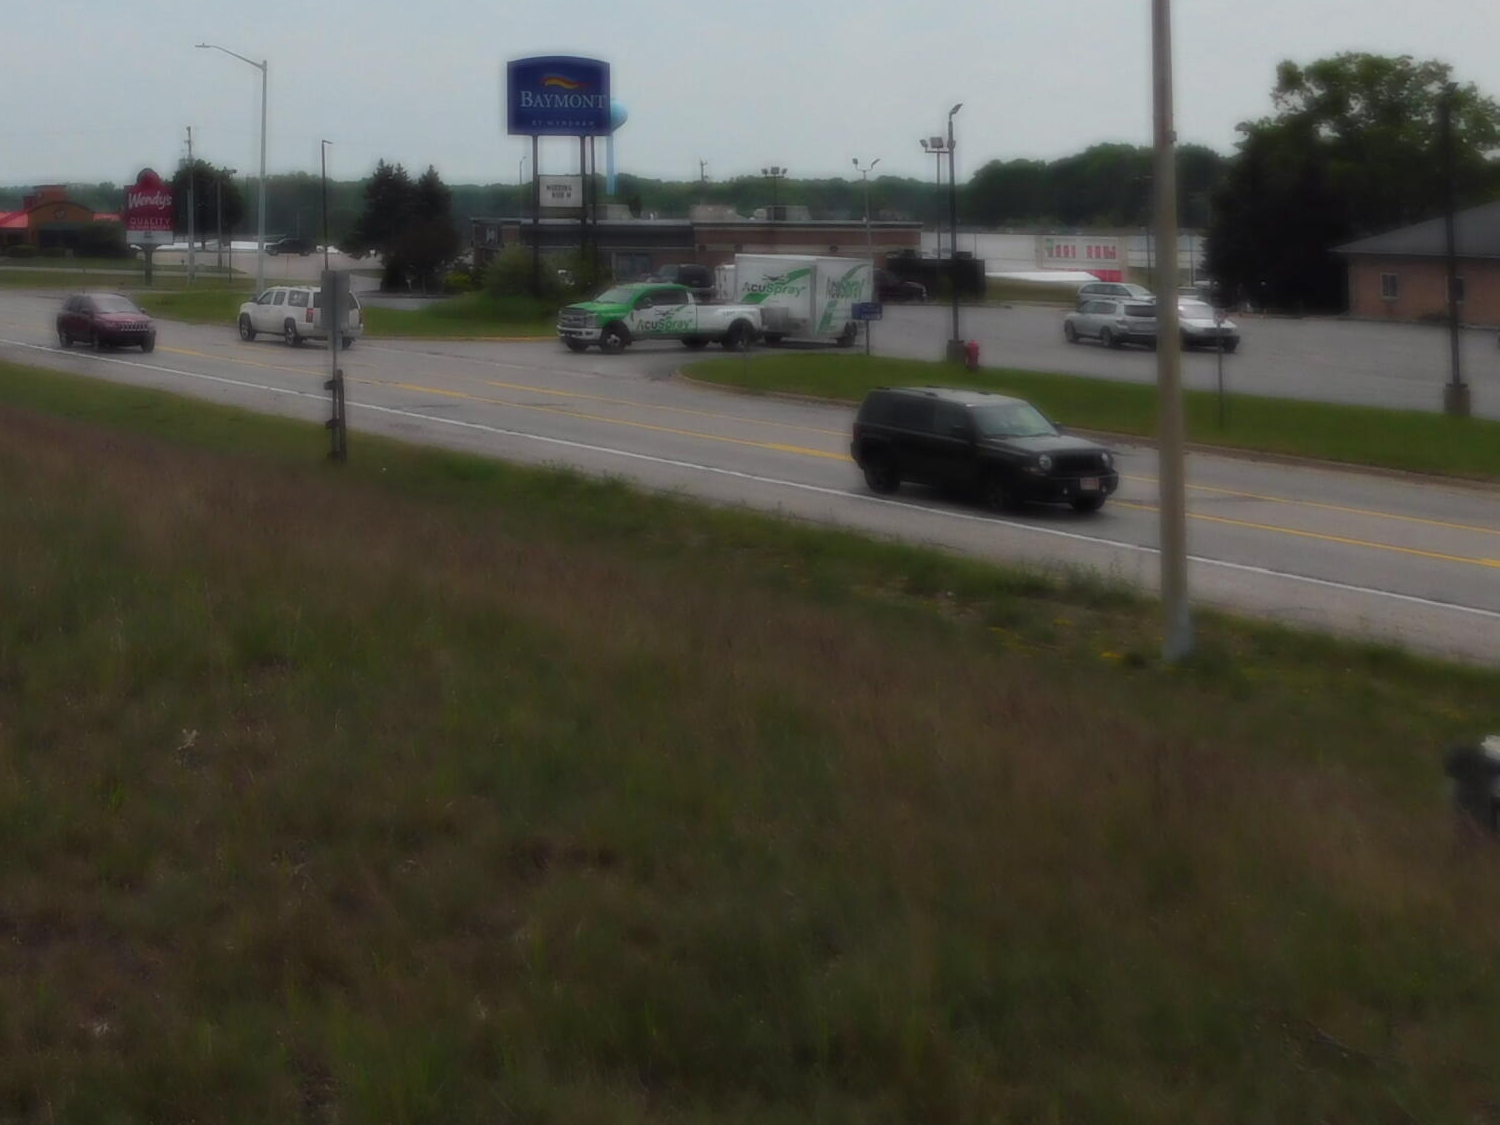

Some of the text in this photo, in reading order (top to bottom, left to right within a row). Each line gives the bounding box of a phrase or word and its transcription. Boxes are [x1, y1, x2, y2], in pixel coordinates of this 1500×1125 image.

[520, 90, 606, 108] BAYMONT
[128, 190, 173, 211] Wendy's
[741, 281, 804, 298] AcuSpray
[635, 319, 691, 333] AcuSpray
